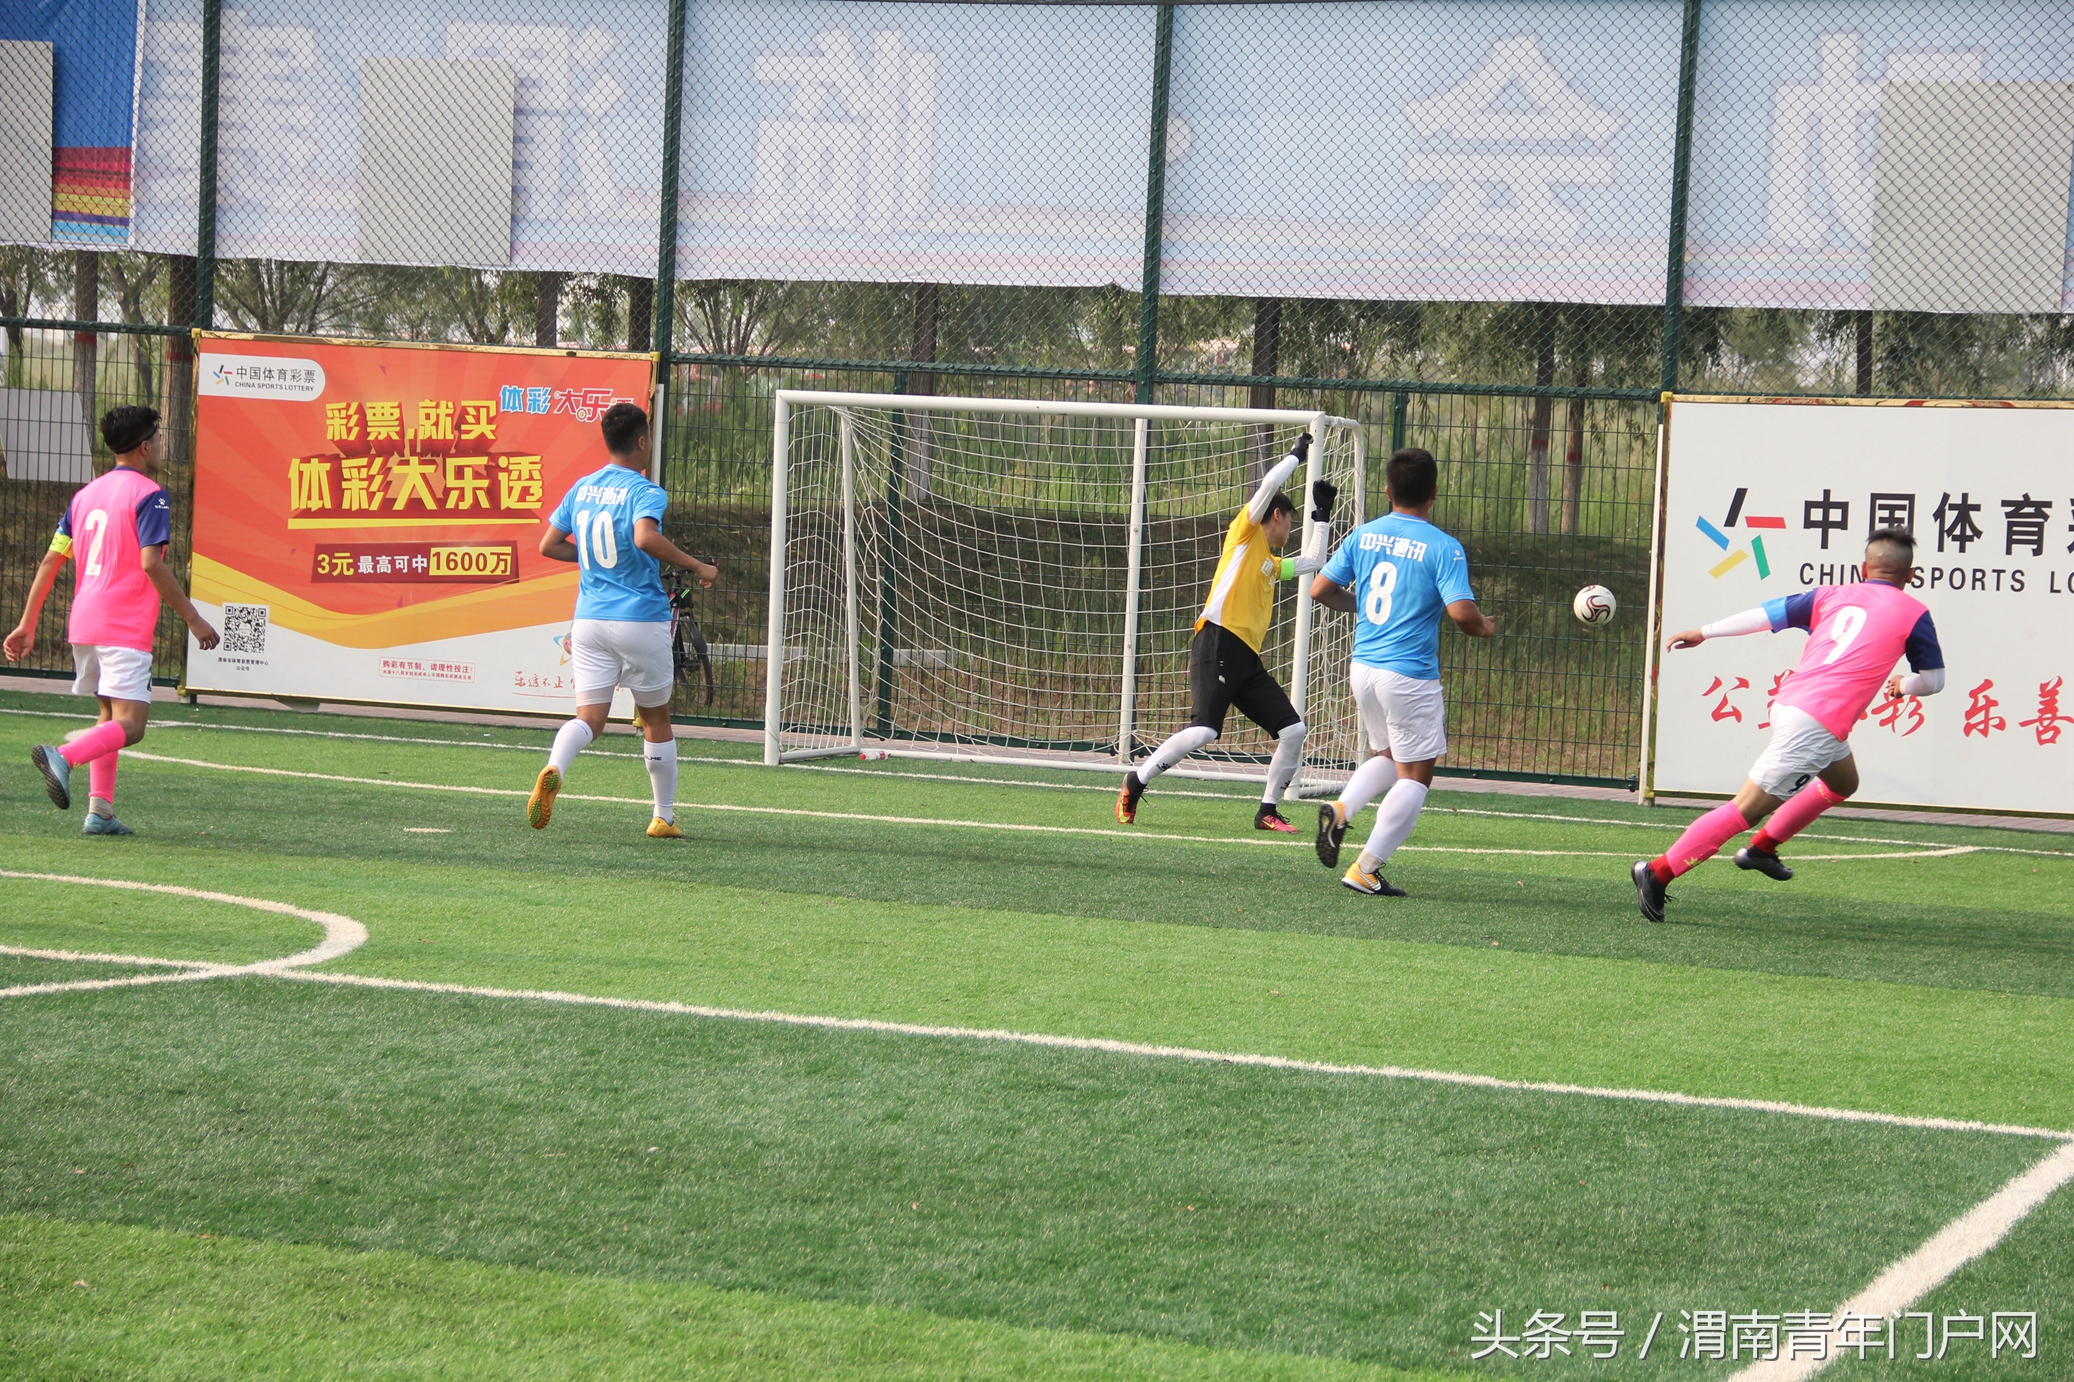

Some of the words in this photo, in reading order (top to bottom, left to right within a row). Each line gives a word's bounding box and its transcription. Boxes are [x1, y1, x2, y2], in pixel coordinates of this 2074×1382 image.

[235, 381, 256, 389] CHINA
[257, 382, 283, 390] SPORTS
[284, 384, 315, 392] LOTTERY
[236, 365, 315, 384] 中国体育彩票
[499, 385, 634, 422] 体彩大乐
[288, 455, 545, 512] 体彩大乐透
[576, 486, 628, 505] 中兴通讯
[84, 508, 109, 577] 2
[575, 510, 619, 570] 10
[1803, 489, 2074, 557] 中国体育
[1359, 532, 1428, 563] 中兴通讯
[1365, 561, 1398, 626] 8
[1800, 562, 1866, 585] CHIN
[1911, 566, 2025, 592] SPORTS
[1822, 605, 1867, 665] 9
[1963, 675, 2074, 747] 乐善
[1787, 773, 1812, 794] 9
